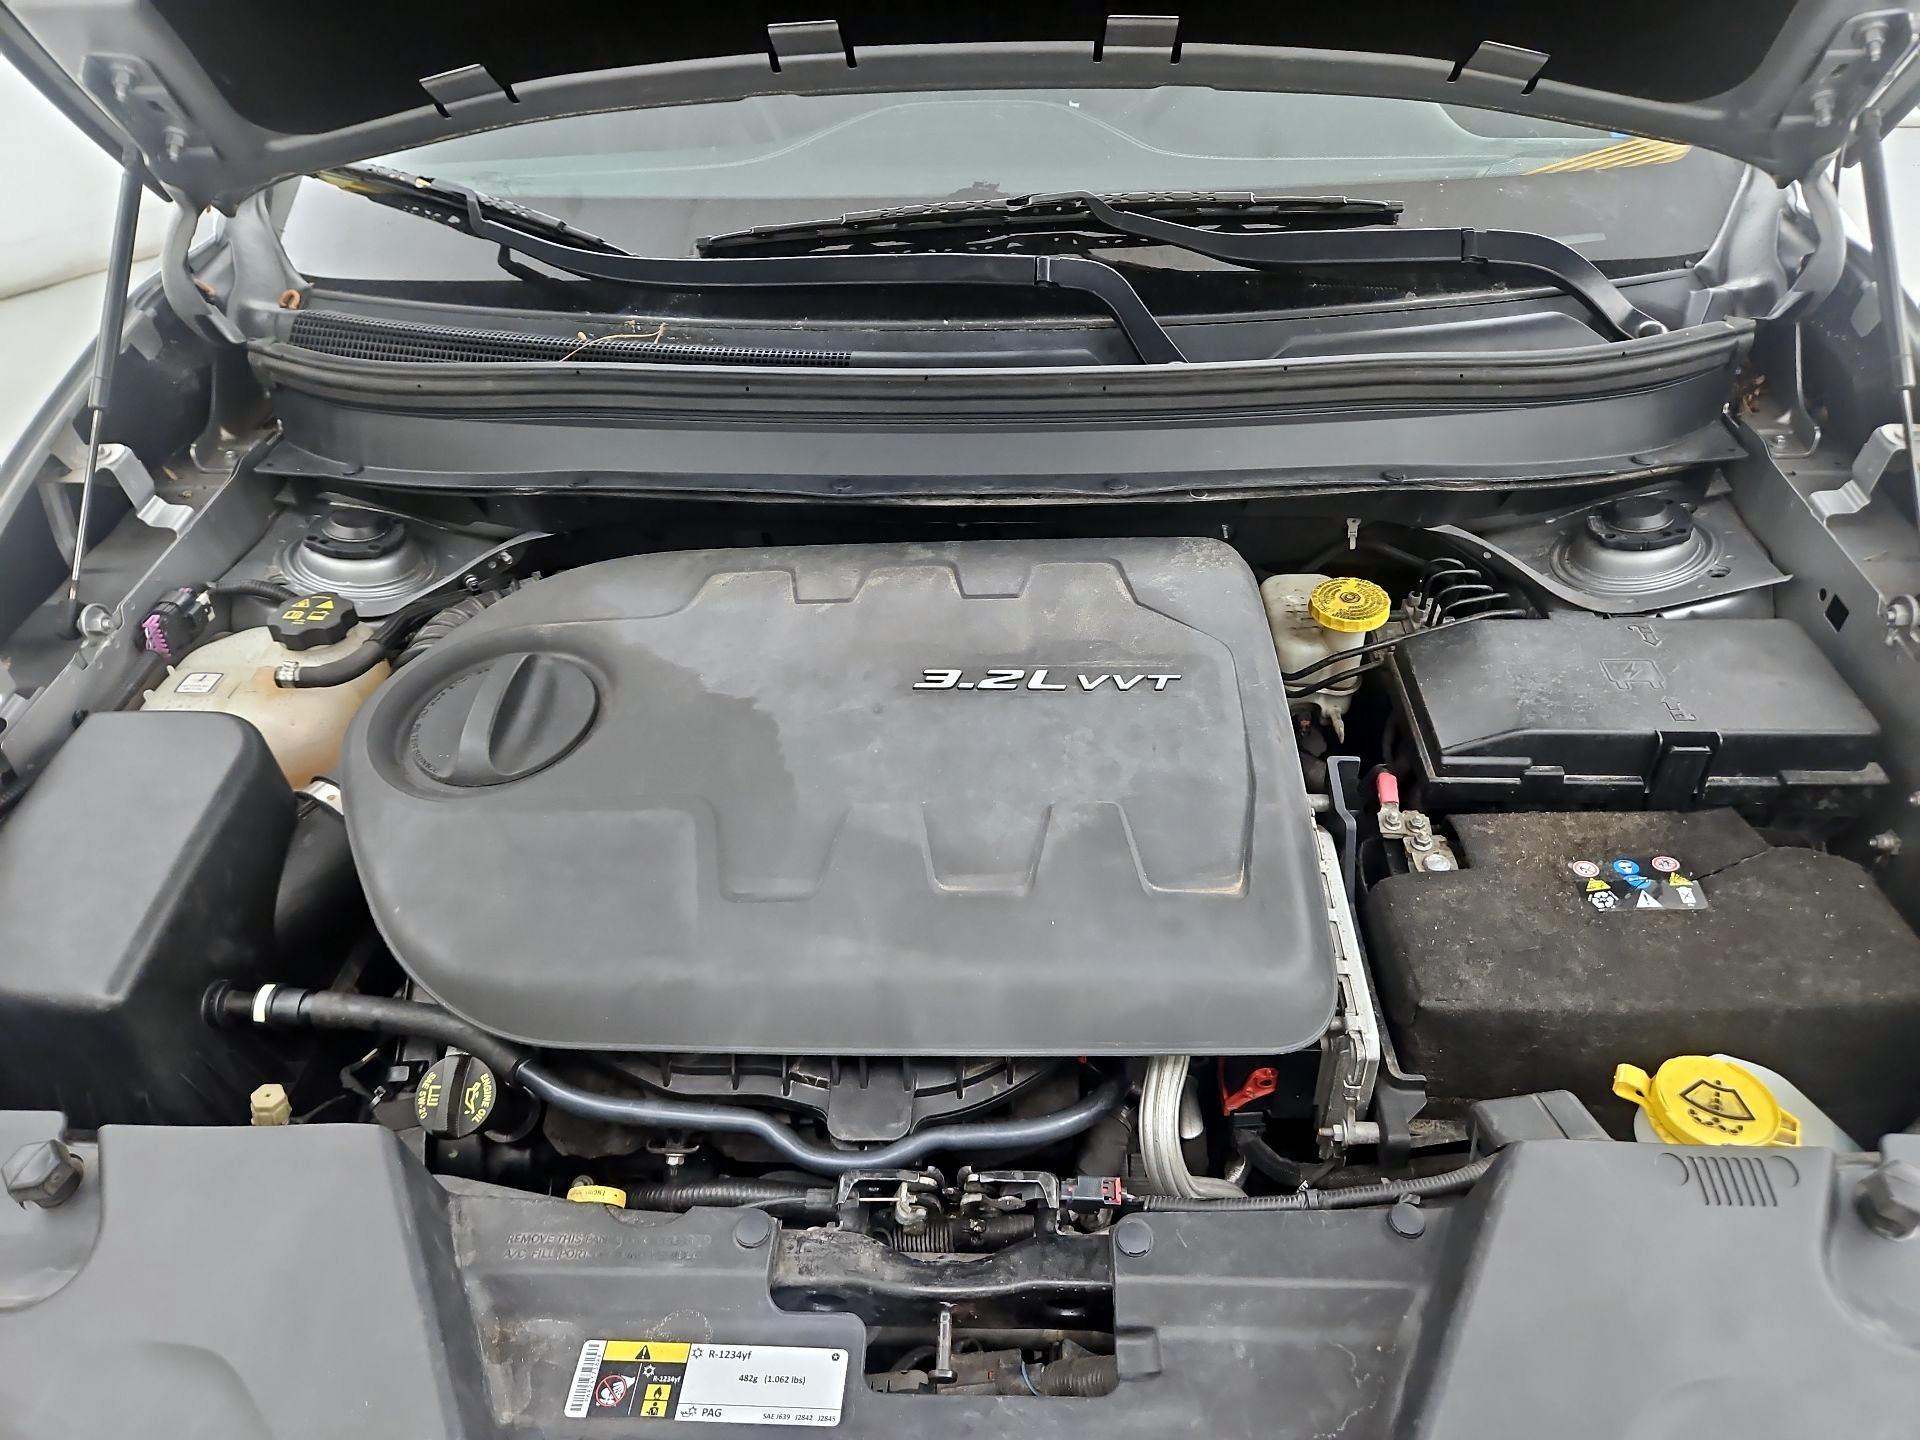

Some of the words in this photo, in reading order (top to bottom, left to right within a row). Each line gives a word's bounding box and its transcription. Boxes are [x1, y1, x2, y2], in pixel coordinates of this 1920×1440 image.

[912, 669, 1067, 691] 3.2L
[1077, 674, 1182, 691] VVT
[480, 1072, 492, 1108] ENGINE
[417, 1090, 428, 1120] 5W-20
[471, 1108, 487, 1124] OIL
[507, 1233, 555, 1244] REMOVE
[558, 1233, 583, 1244] THIS
[503, 1249, 527, 1260] A/C
[708, 1349, 753, 1362] R-1234yf
[652, 1375, 682, 1384] R-1234yf
[738, 1374, 758, 1384] 482g
[764, 1374, 790, 1384] (1.062
[791, 1376, 806, 1386] lbs)
[701, 1407, 723, 1418] PAG
